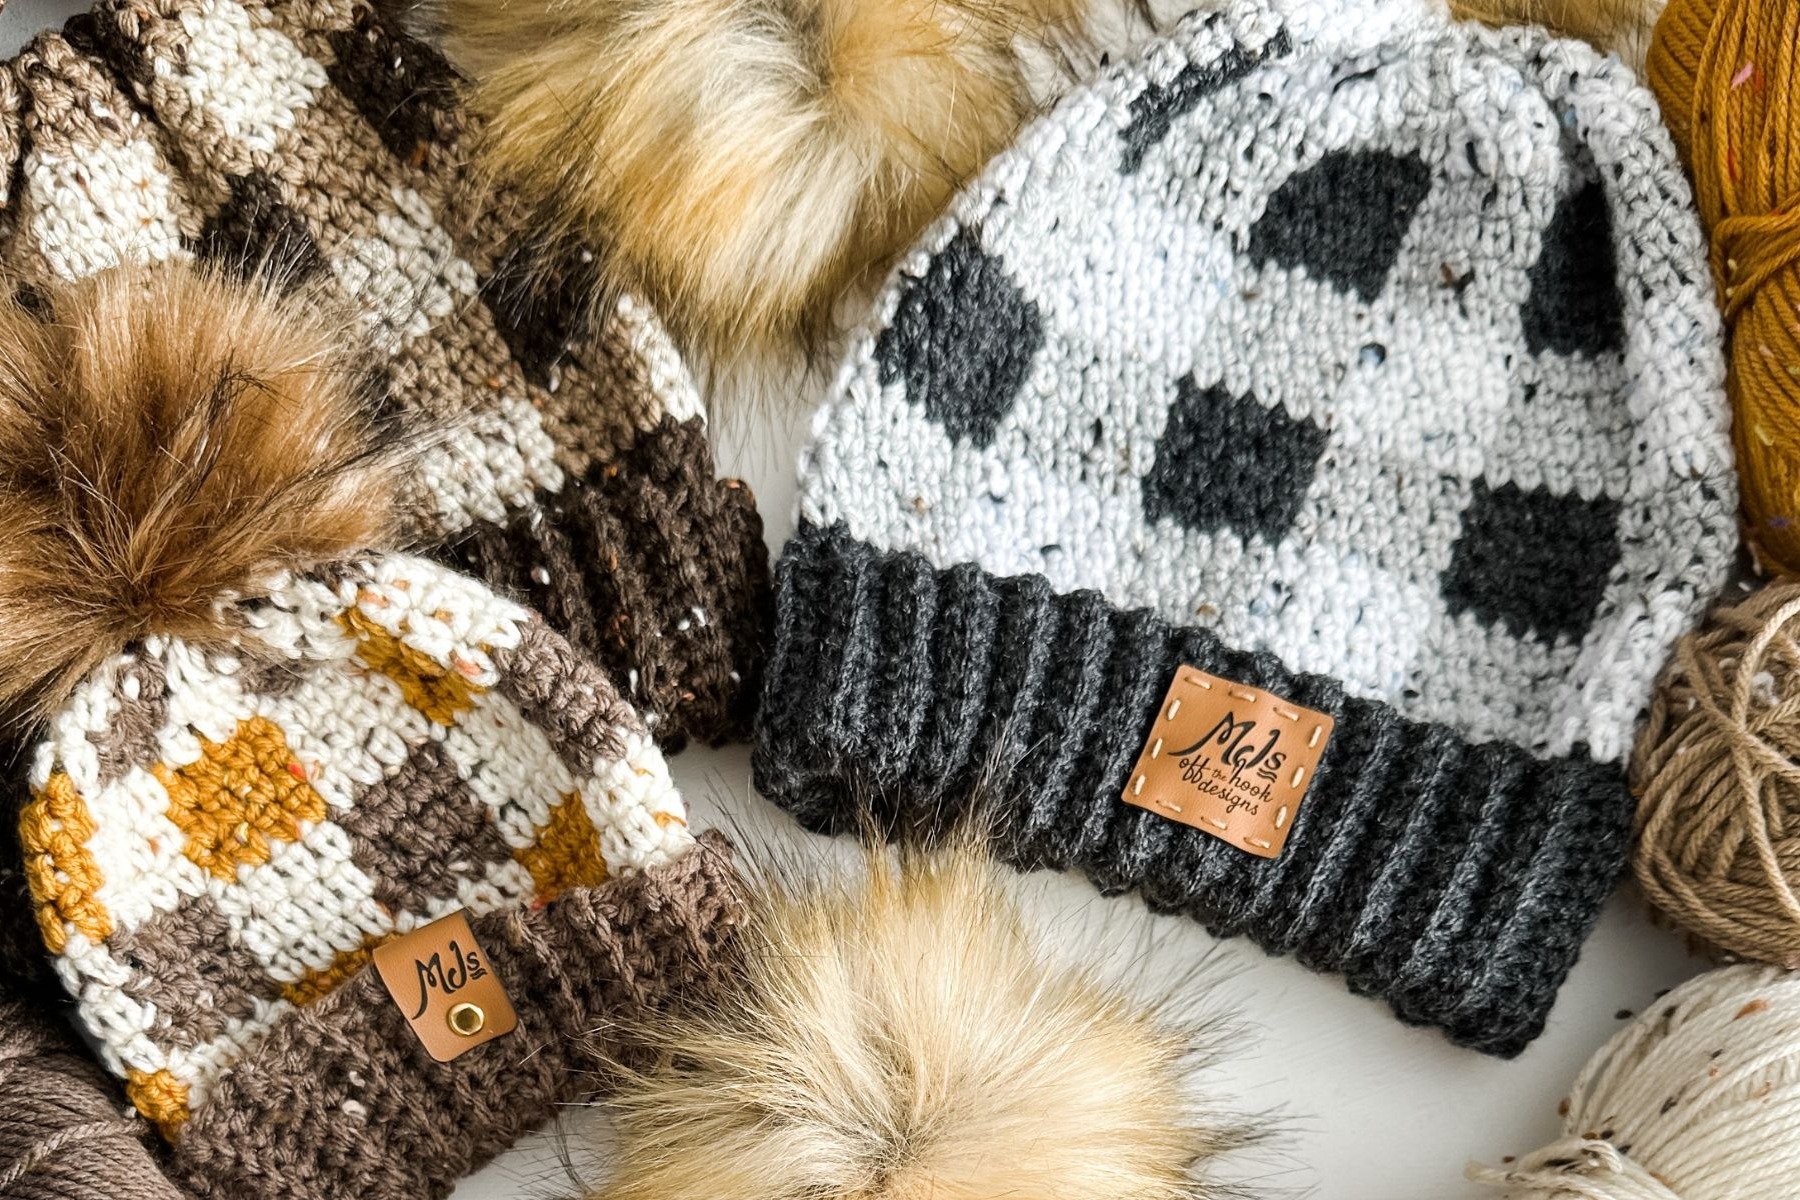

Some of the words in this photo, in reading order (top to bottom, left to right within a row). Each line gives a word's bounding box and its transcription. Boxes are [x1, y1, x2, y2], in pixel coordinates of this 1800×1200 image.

[1178, 755, 1211, 783] off
[1211, 768, 1228, 782] the
[1228, 758, 1273, 803] hook
[1197, 778, 1260, 815] designs
